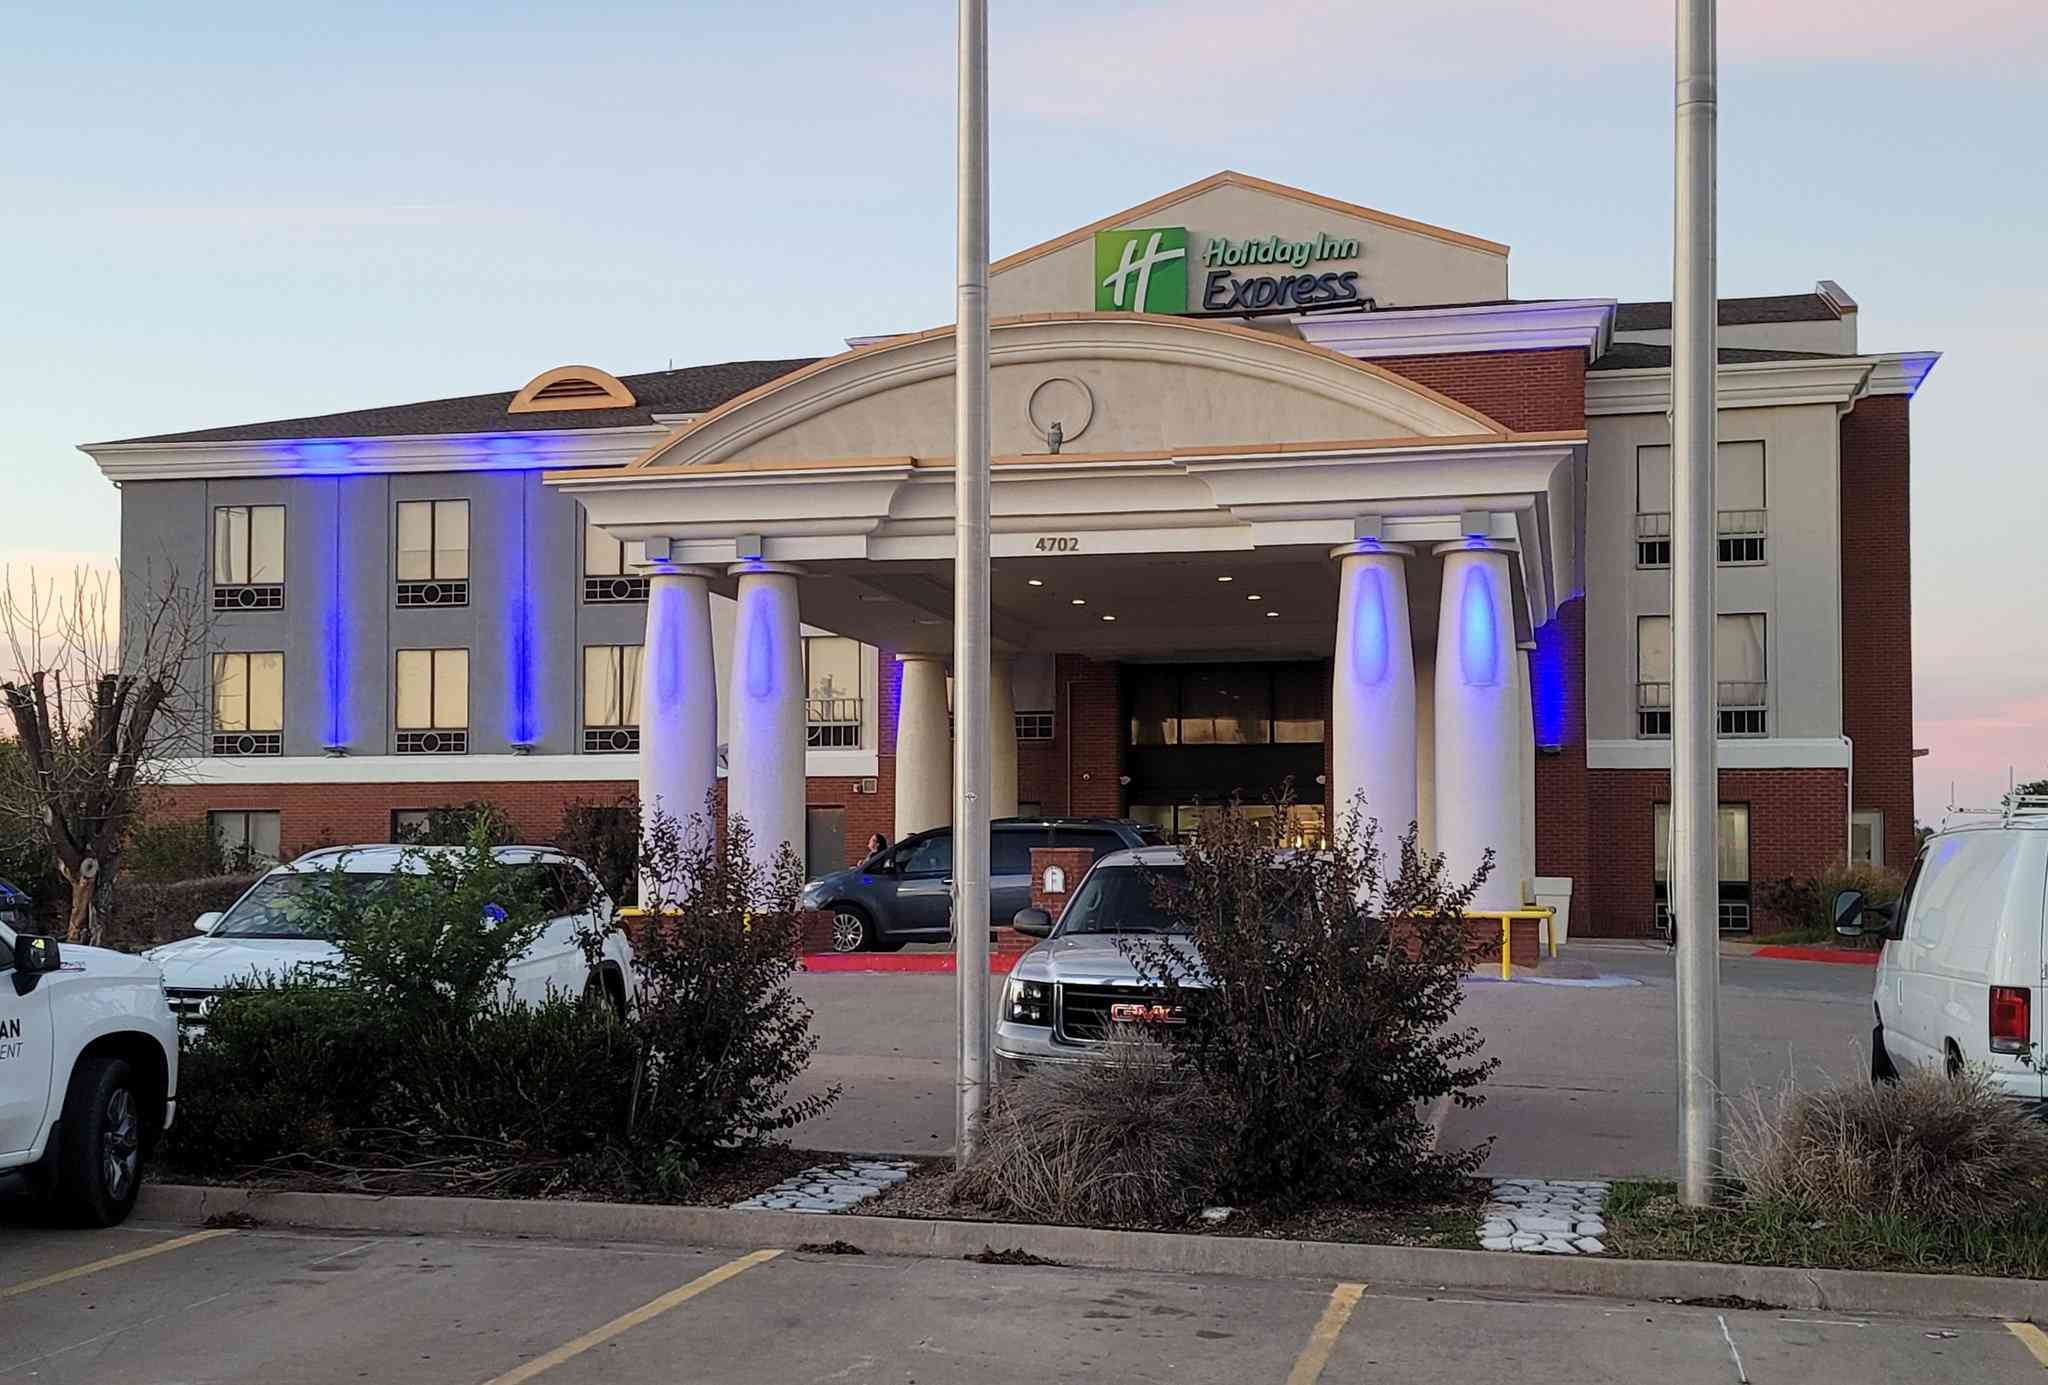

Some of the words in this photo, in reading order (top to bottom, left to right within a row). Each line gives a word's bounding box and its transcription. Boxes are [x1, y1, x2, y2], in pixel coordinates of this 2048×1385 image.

[1204, 236, 1313, 268] Holiday
[1314, 232, 1360, 260] Inn
[1103, 232, 1185, 313] H
[1203, 270, 1359, 310] Express
[1034, 536, 1080, 552] 4702
